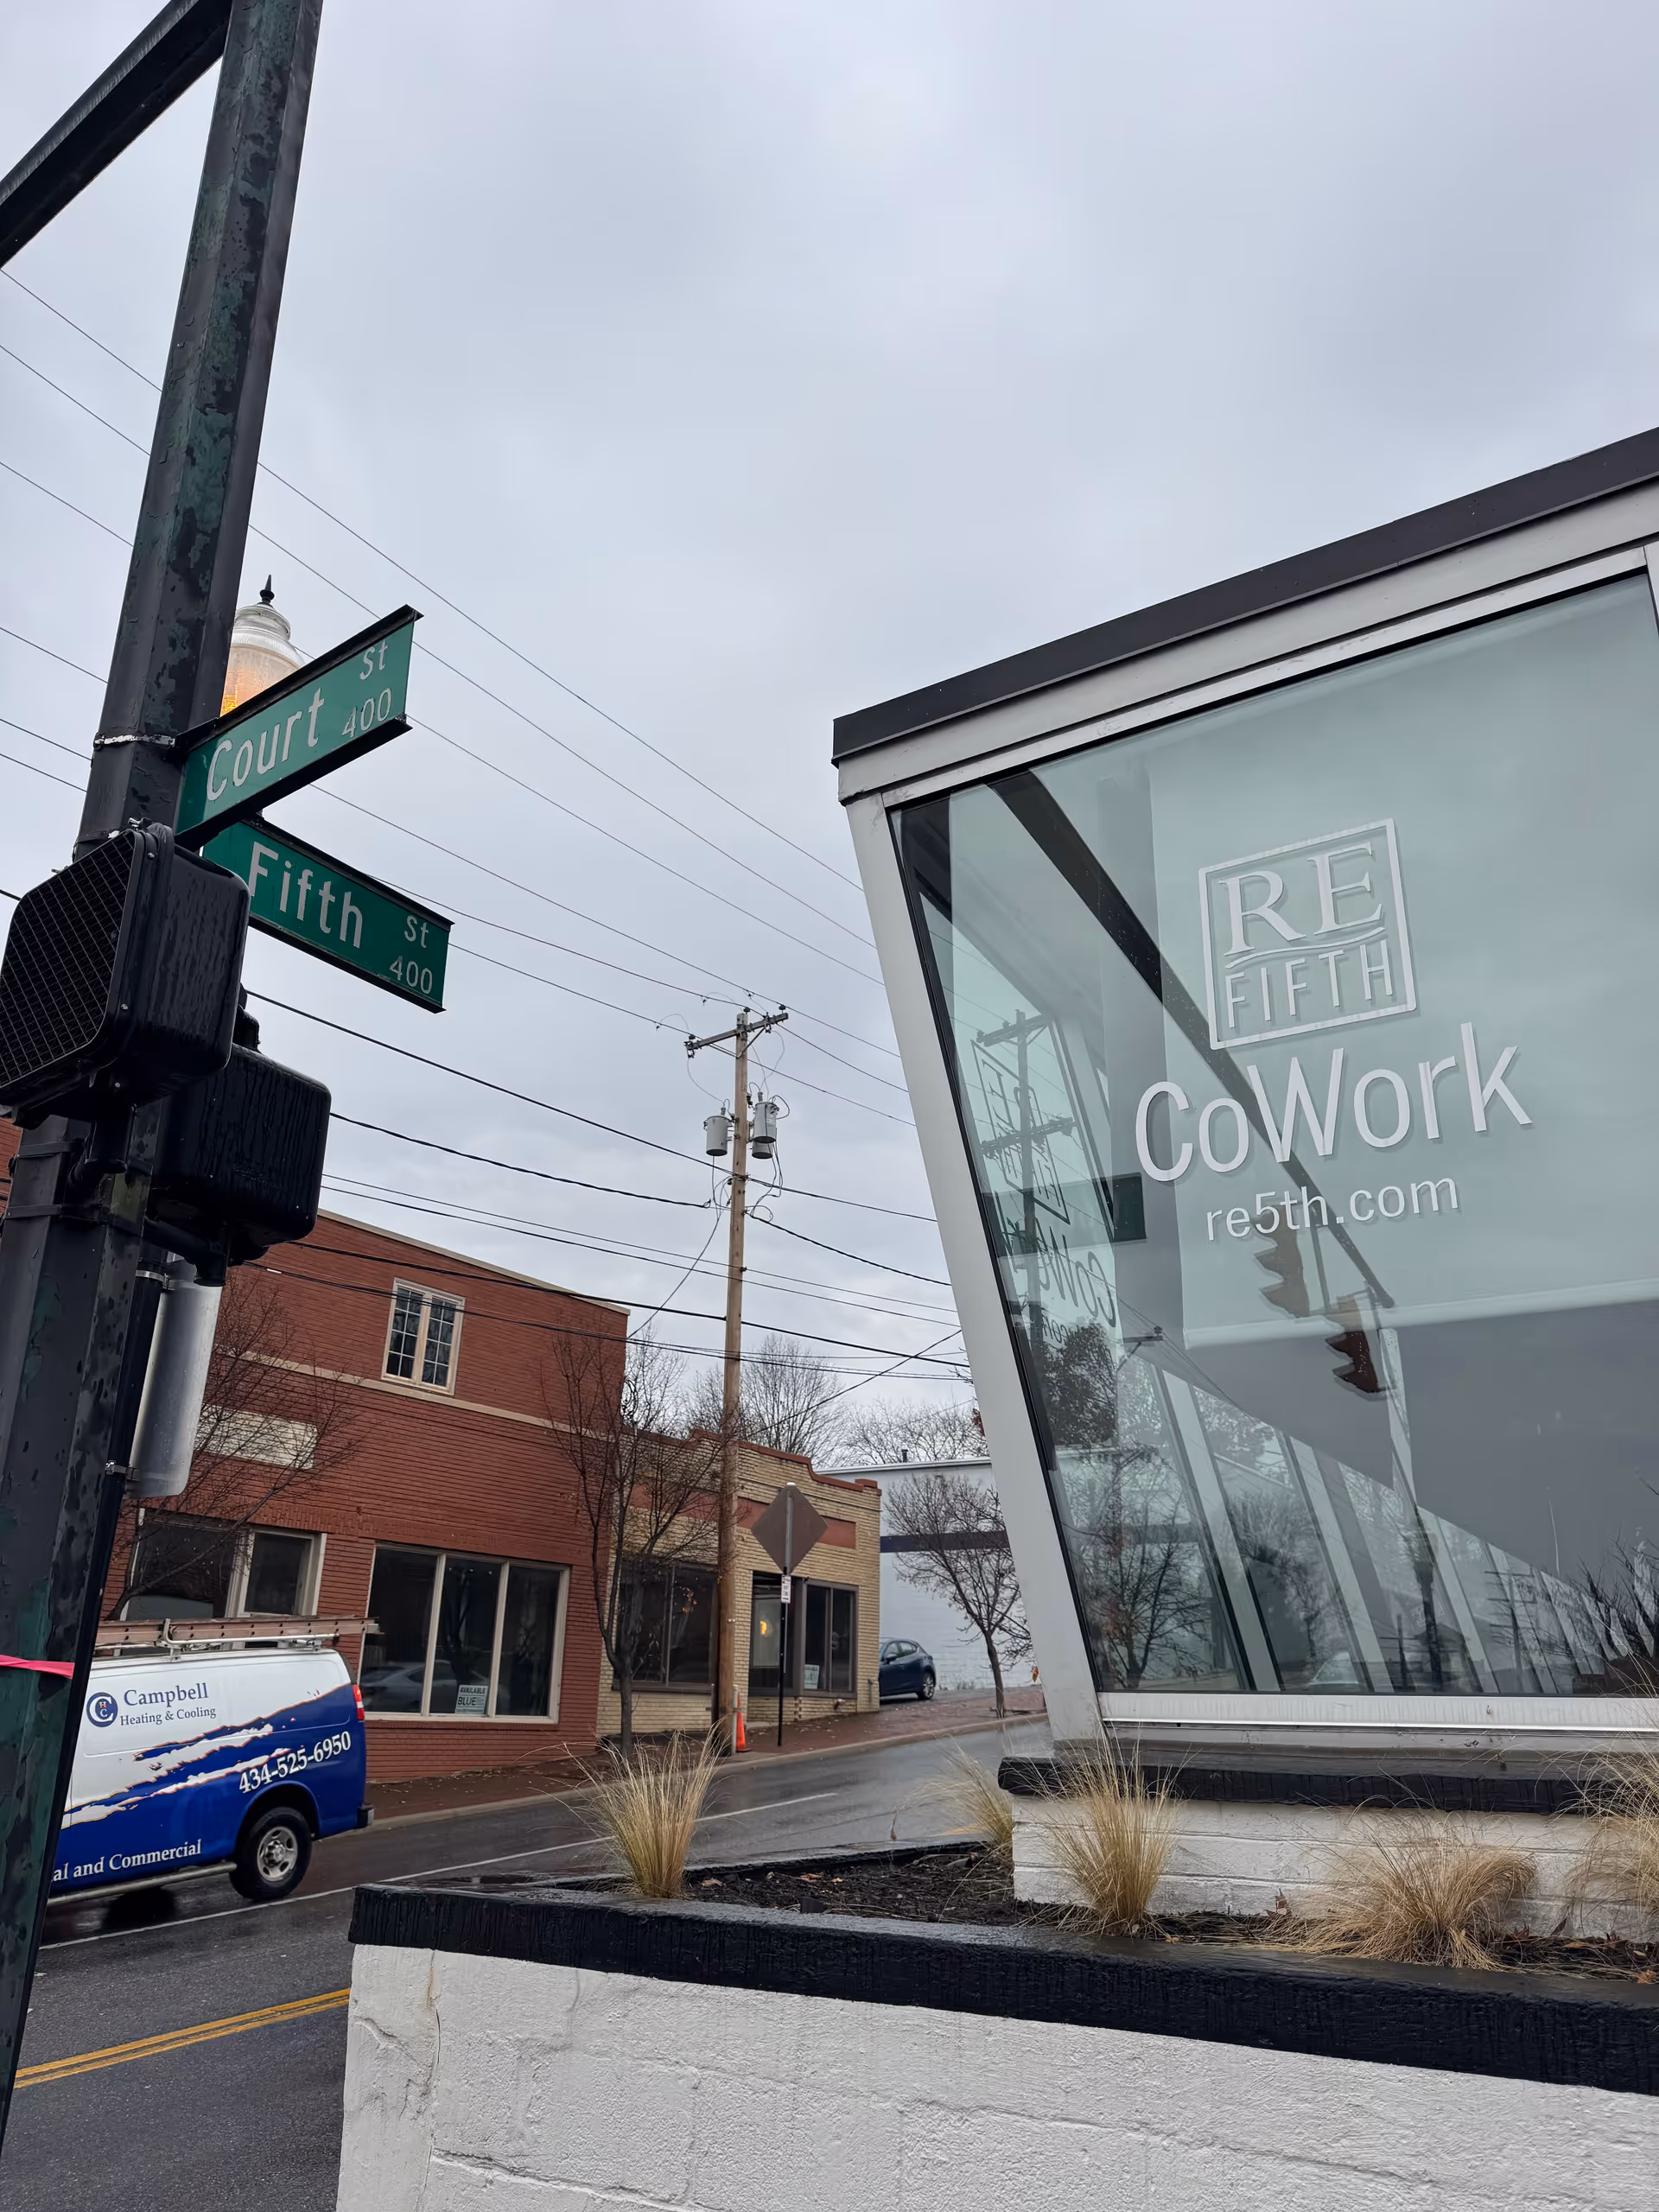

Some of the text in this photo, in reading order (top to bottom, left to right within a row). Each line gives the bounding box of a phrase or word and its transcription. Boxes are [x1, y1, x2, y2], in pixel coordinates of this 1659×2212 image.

[207, 639, 388, 802] Court St
[341, 688, 392, 739] 400
[249, 840, 429, 949] Fifth St
[1217, 841, 1383, 957] RE
[389, 955, 433, 995] 400
[1224, 939, 1393, 1029] FIFTH
[1135, 1021, 1533, 1182] CoWork
[1206, 1177, 1459, 1241] re5th.com
[120, 1707, 216, 1726] Heating & Cooling
[124, 1682, 208, 1707] Campbell
[458, 1696, 477, 1706] BLUE
[239, 1731, 351, 1794] 434-525-6950
[51, 1839, 201, 1882] al and Commercial
